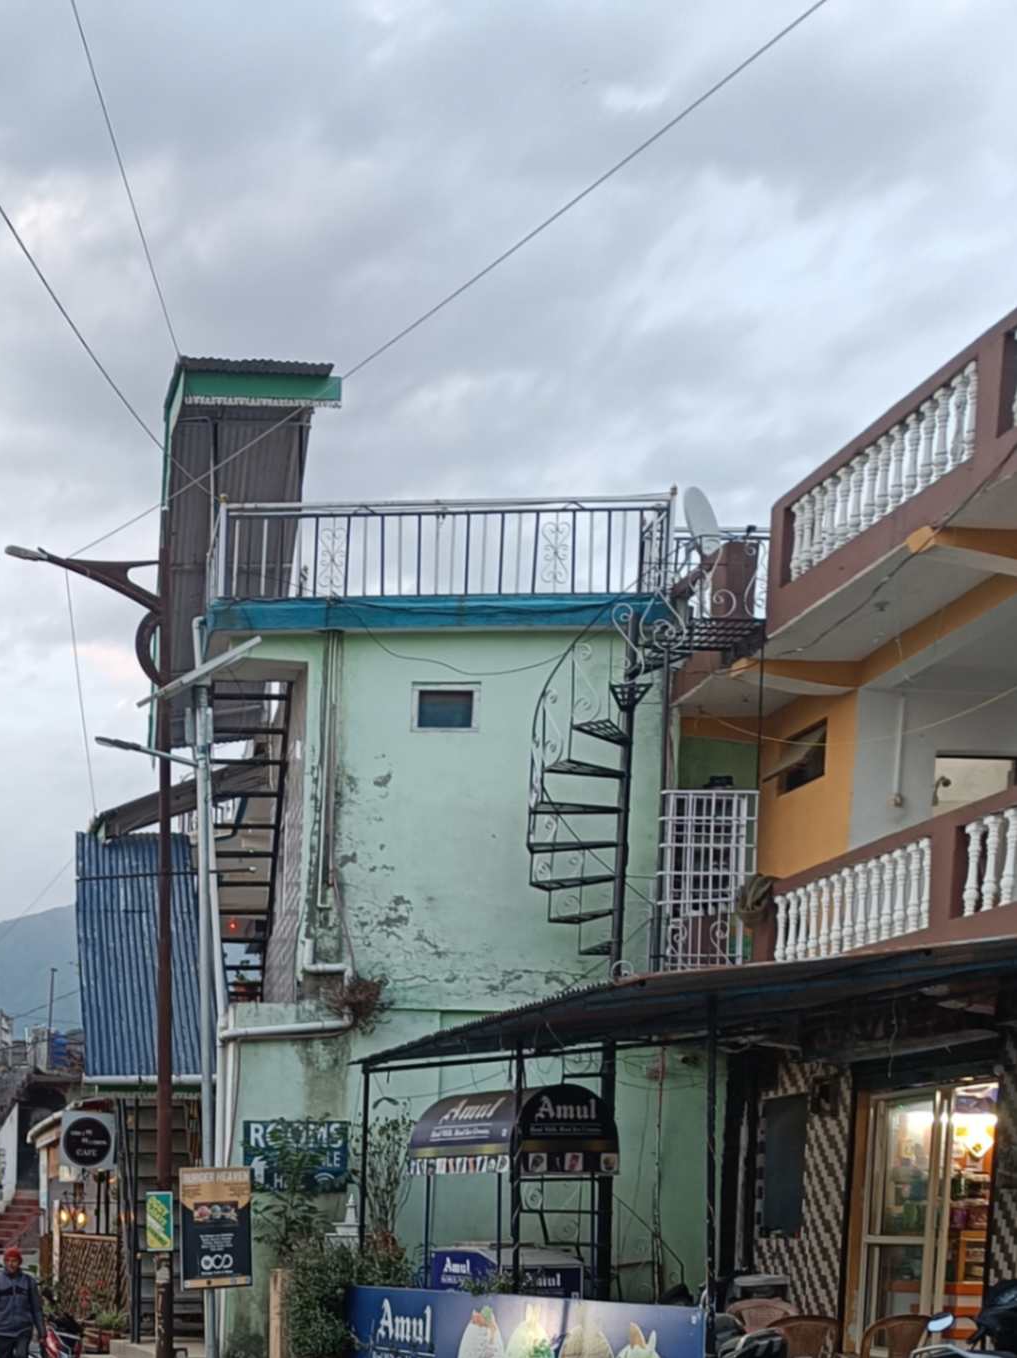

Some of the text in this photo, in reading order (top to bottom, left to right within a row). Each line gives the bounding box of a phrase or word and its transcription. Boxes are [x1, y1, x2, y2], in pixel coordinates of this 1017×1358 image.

[440, 1097, 506, 1123] Amul
[534, 1095, 597, 1121] Amul
[443, 1257, 471, 1274] Amul
[376, 1298, 432, 1345] Amul
